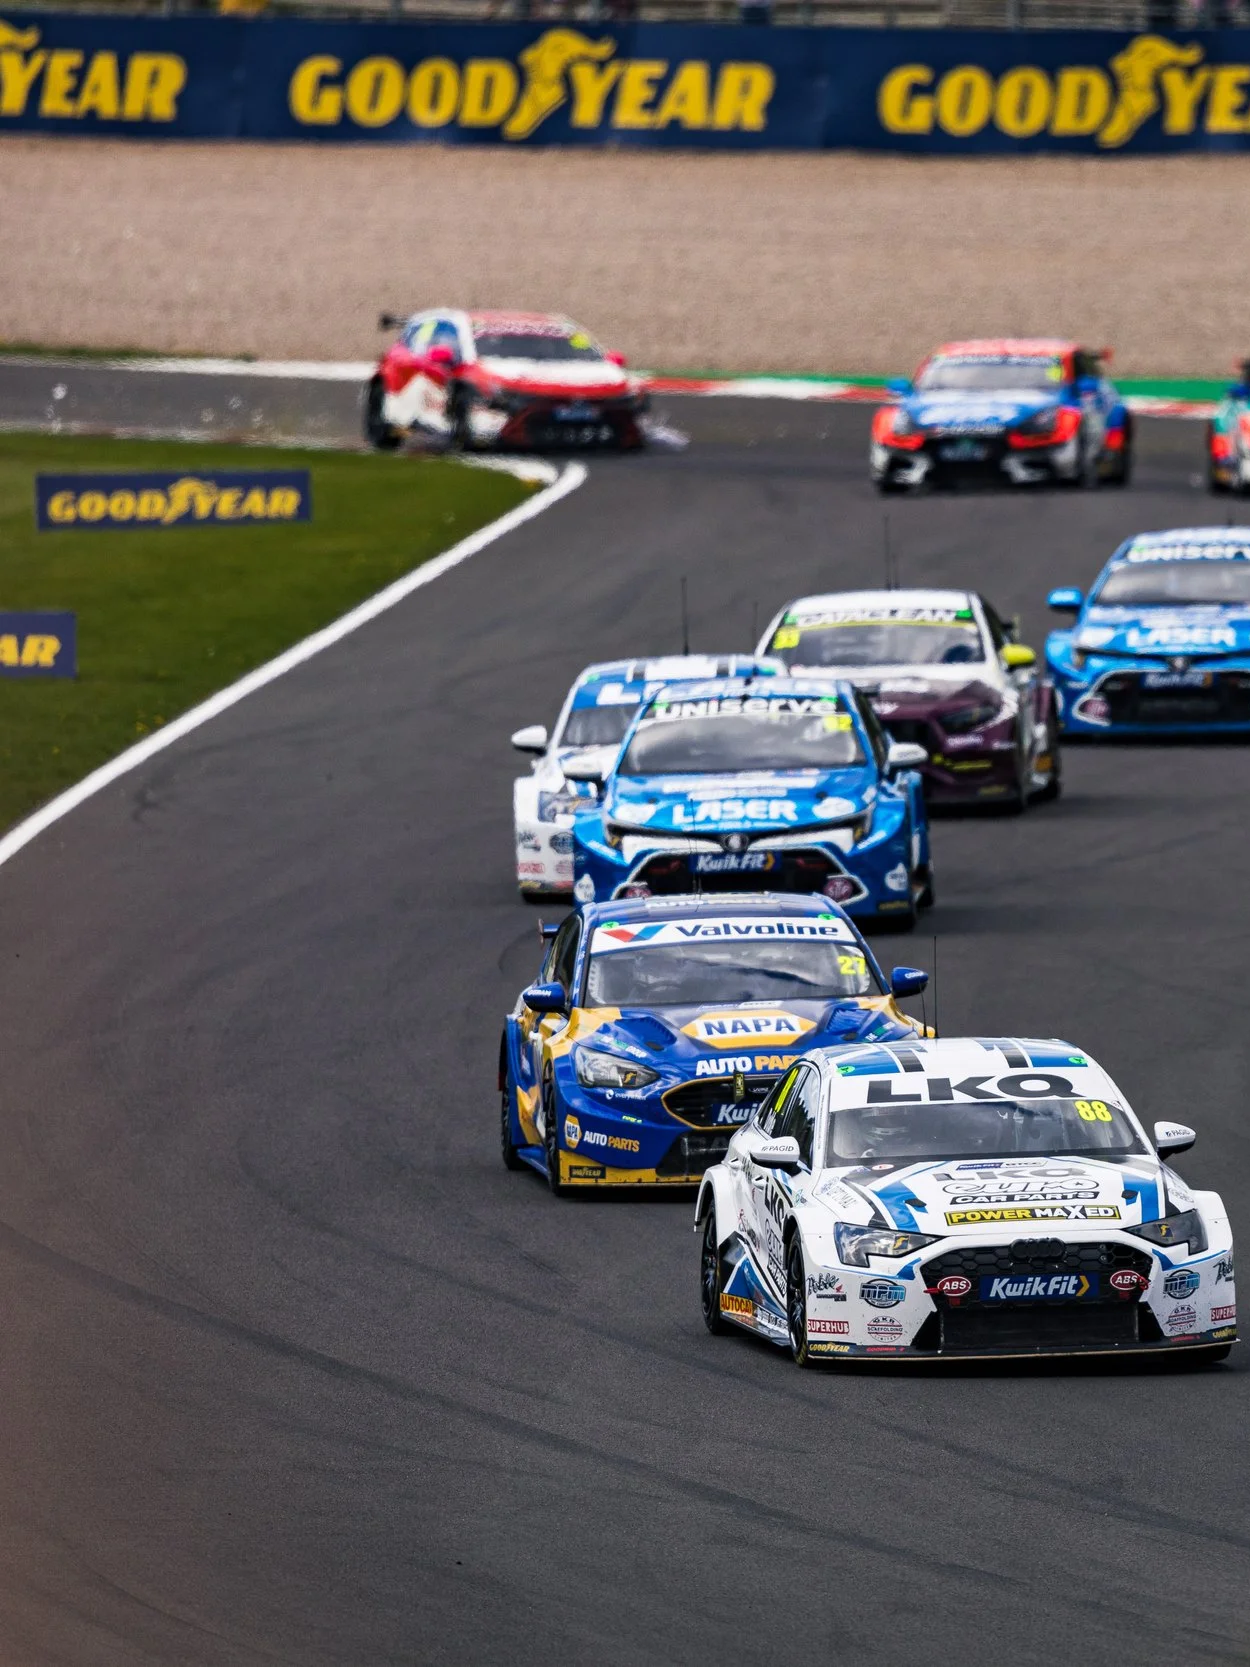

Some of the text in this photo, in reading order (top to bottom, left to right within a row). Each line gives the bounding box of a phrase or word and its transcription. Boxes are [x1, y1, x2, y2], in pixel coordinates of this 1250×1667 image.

[0, 50, 185, 120] YEAR
[48, 486, 301, 522] GOODYEAR
[672, 799, 798, 825] LASER
[675, 921, 839, 937] Valvoline
[837, 955, 867, 975] 27
[703, 1017, 796, 1036] NAPA
[695, 1055, 801, 1076] AUTO PAR
[866, 1073, 1086, 1104] LKQ
[717, 1103, 758, 1124] Kwi
[1074, 1099, 1114, 1122] 88
[583, 1130, 640, 1152] AUTO PARTS
[933, 1167, 1087, 1182] LKQ
[955, 1191, 1096, 1204] CAR PARTS
[952, 1205, 1115, 1223] POWER MAXED
[943, 1280, 967, 1290] ABS
[807, 1320, 849, 1333] SUPERHUB
[809, 1343, 850, 1352] GOODYEAR
